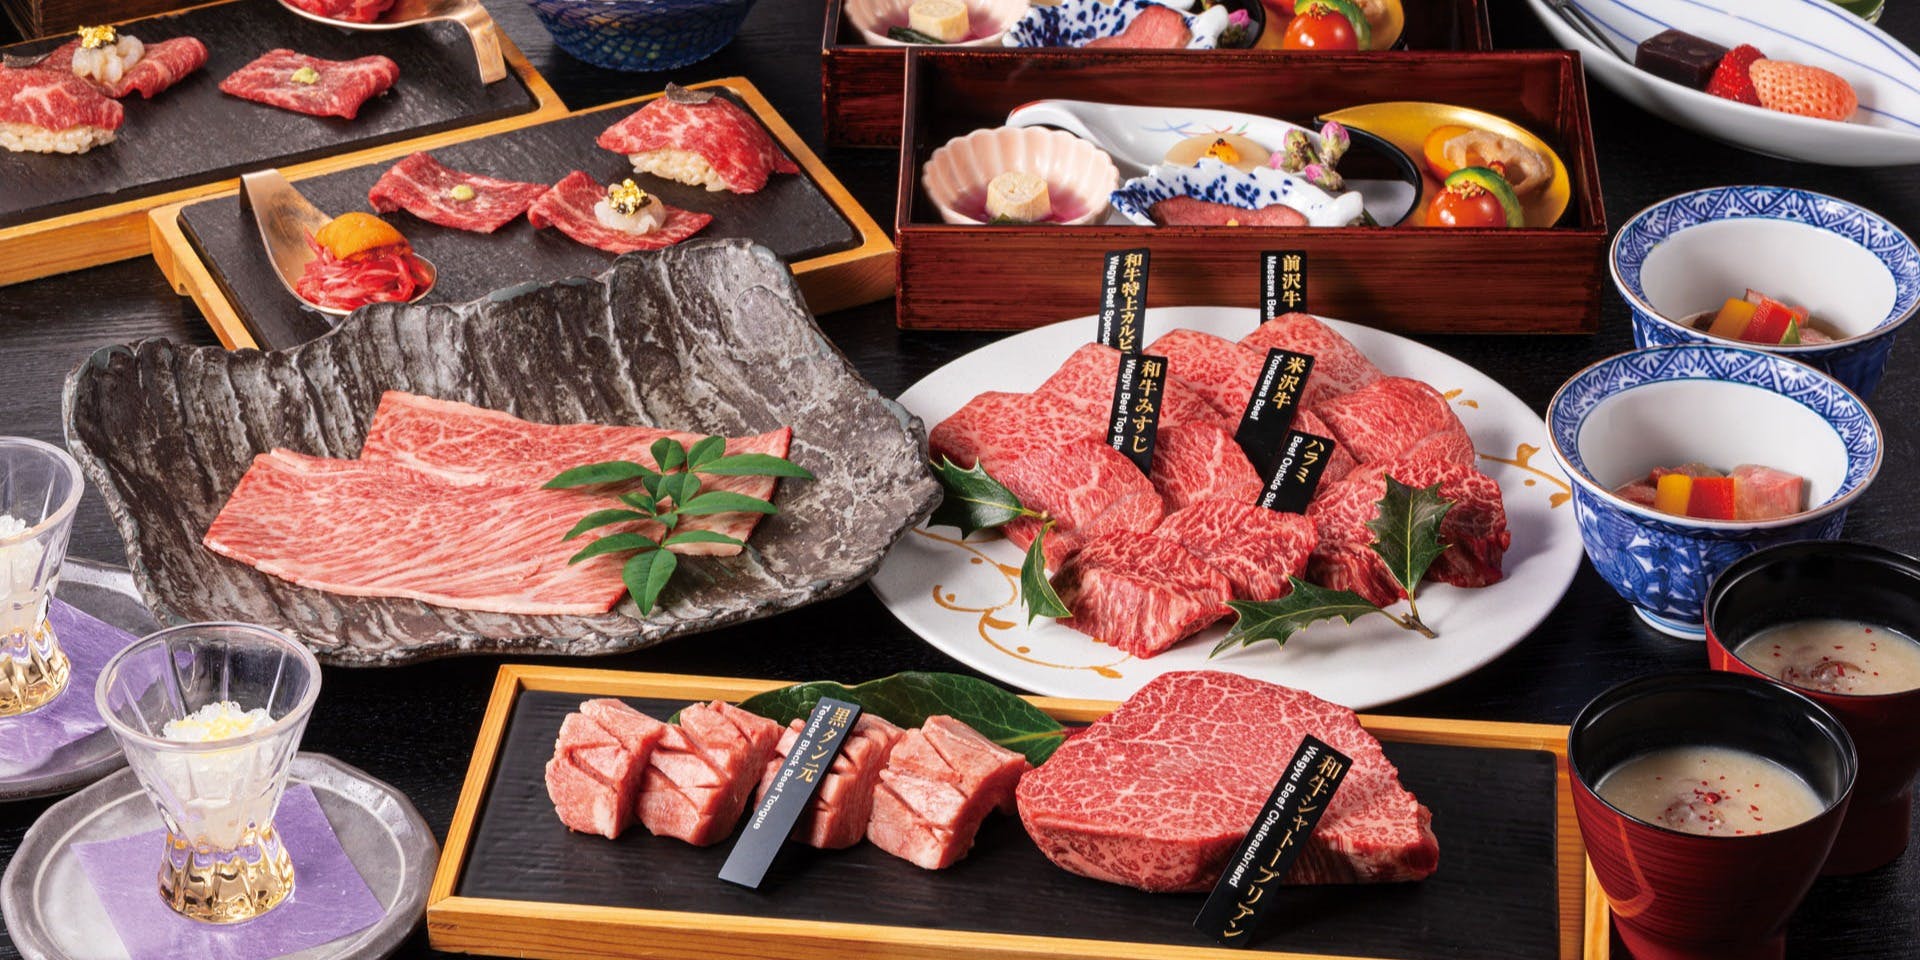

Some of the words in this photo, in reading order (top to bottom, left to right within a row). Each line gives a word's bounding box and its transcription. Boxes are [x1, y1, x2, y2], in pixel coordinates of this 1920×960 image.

[1106, 255, 1119, 286] Wagyu
[1267, 255, 1277, 298] Maesawa
[1282, 254, 1301, 308] 前沢牛
[1106, 287, 1117, 308] Beef
[1118, 253, 1143, 354] 和牛特上カルビ
[1267, 299, 1277, 320] Beef
[1122, 359, 1136, 391] Wagyu
[1259, 354, 1284, 398] Yonezawa
[1272, 356, 1306, 410] 米沢牛
[1118, 392, 1131, 415] Beef
[1132, 360, 1161, 453] 和牛みすじ
[1249, 398, 1265, 421] Beef
[1113, 416, 1127, 433] Top
[1286, 435, 1303, 457] Beef
[1296, 440, 1325, 484] ハラミ
[1270, 457, 1293, 491] Outside
[806, 704, 832, 739] Tender
[788, 739, 810, 767] Black
[795, 706, 851, 784] 黒タン元
[1290, 744, 1319, 782] Wagyu
[774, 769, 794, 793] Beef
[1277, 783, 1297, 811] Beef
[753, 794, 780, 831] Tongue
[1223, 754, 1343, 938] 和牛シャトーブリアン
[1228, 811, 1280, 888] Chateaubriand
